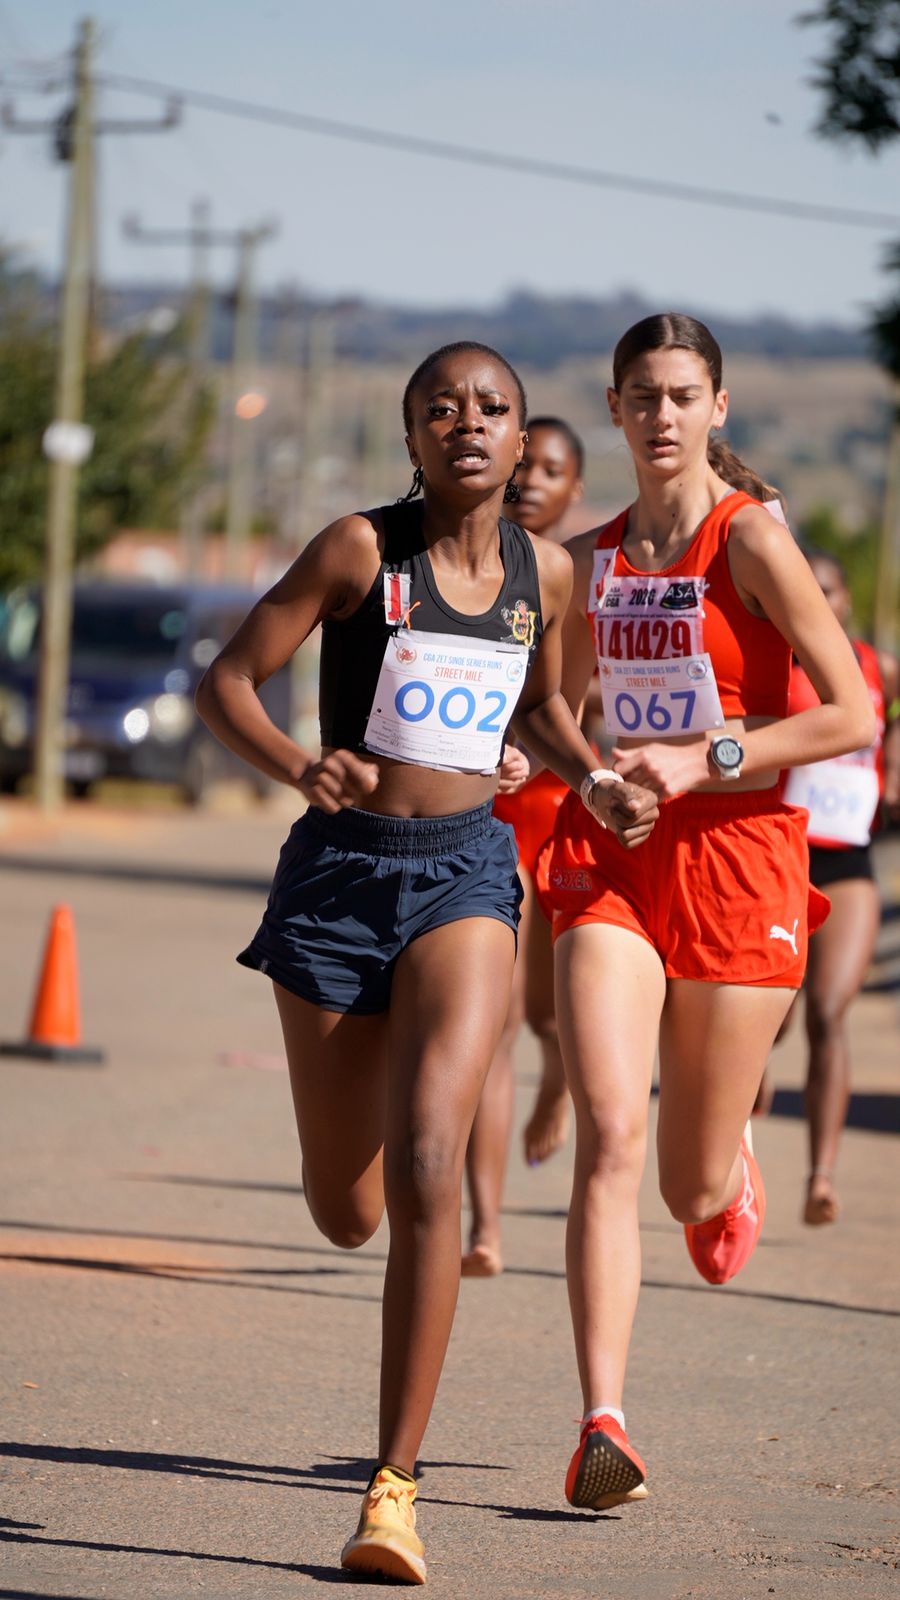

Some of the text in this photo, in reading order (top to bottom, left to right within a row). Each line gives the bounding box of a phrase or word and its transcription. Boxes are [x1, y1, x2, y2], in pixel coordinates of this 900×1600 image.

[666, 584, 694, 597] ASA
[466, 657, 486, 668] SERIES
[487, 660, 503, 670] RUNS
[434, 666, 484, 682] STREET MILE
[625, 676, 667, 688] STREET MILE
[395, 680, 507, 733] 002
[615, 690, 696, 731] 067
